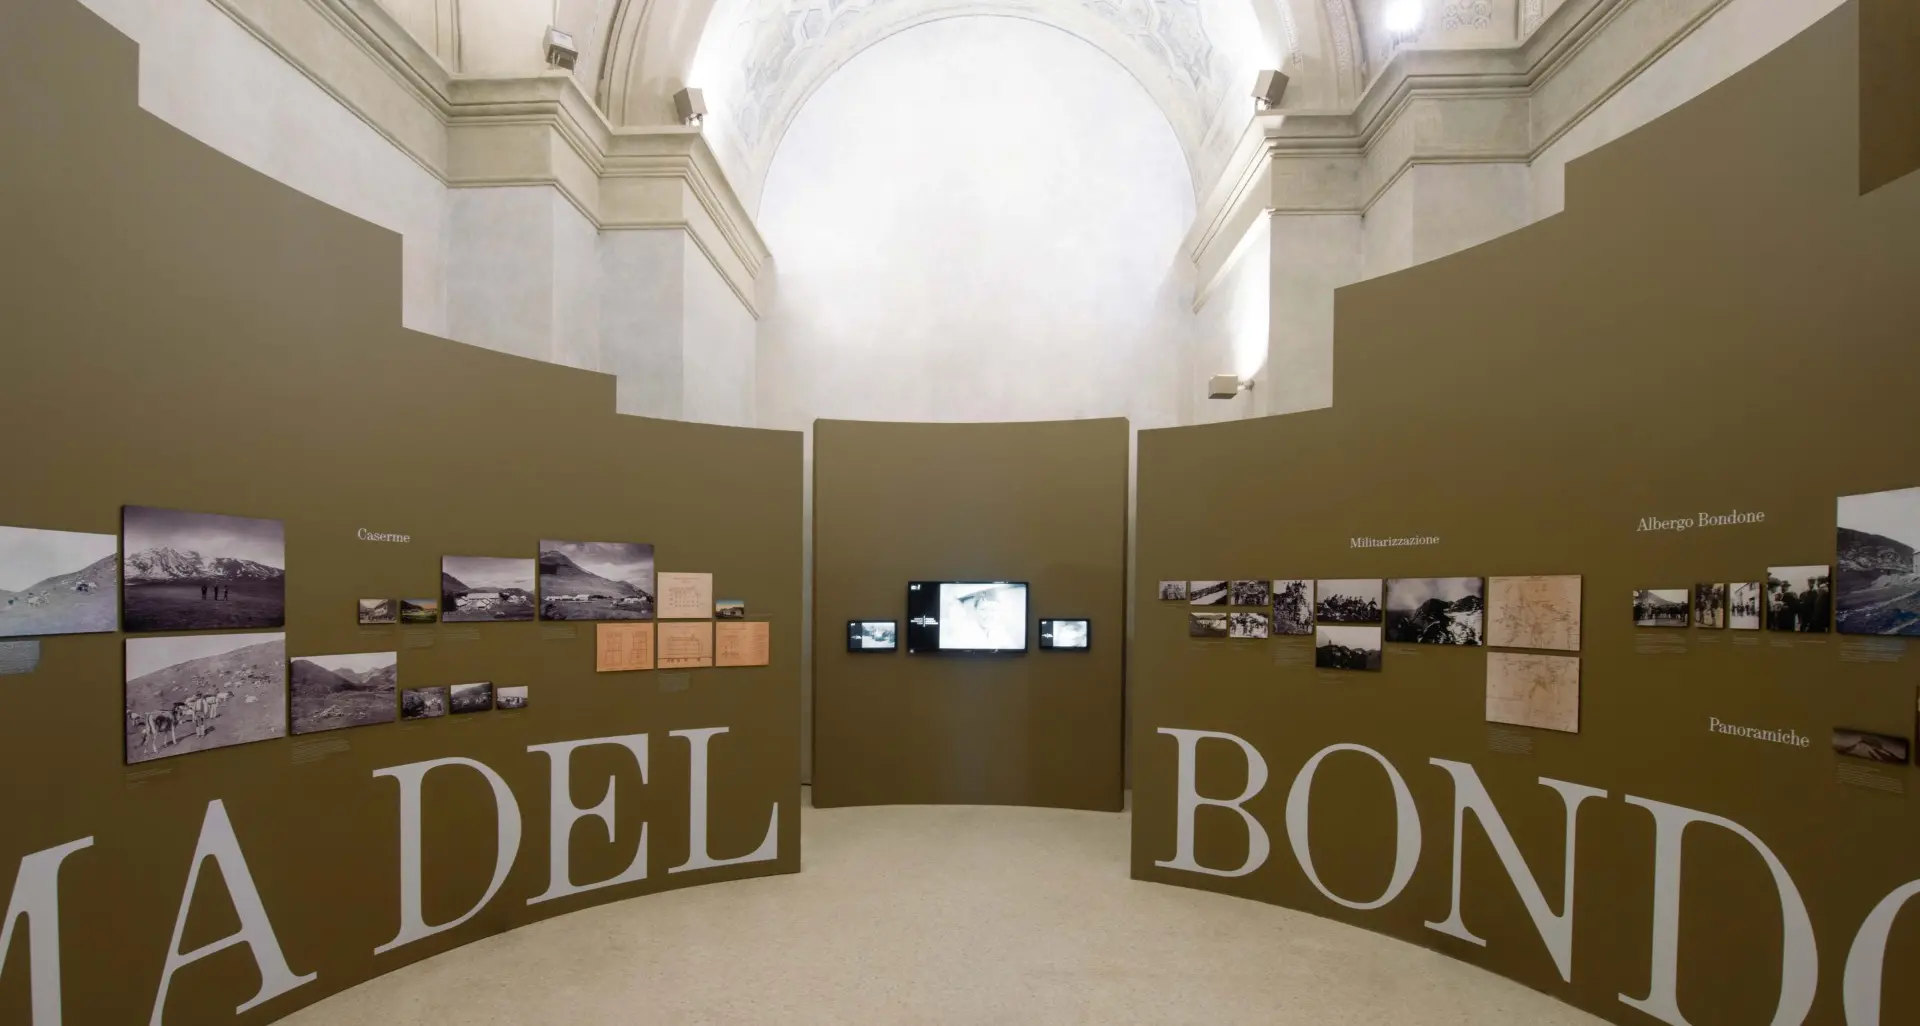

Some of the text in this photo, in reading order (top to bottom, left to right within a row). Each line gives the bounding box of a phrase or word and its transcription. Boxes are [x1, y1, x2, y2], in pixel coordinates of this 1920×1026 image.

[1636, 509, 1765, 532] Albergo Bondone
[357, 527, 411, 543] Caserme
[1350, 534, 1440, 549] Militarizzazione
[1709, 716, 1810, 748] Panoramiche
[373, 726, 779, 955] DEL
